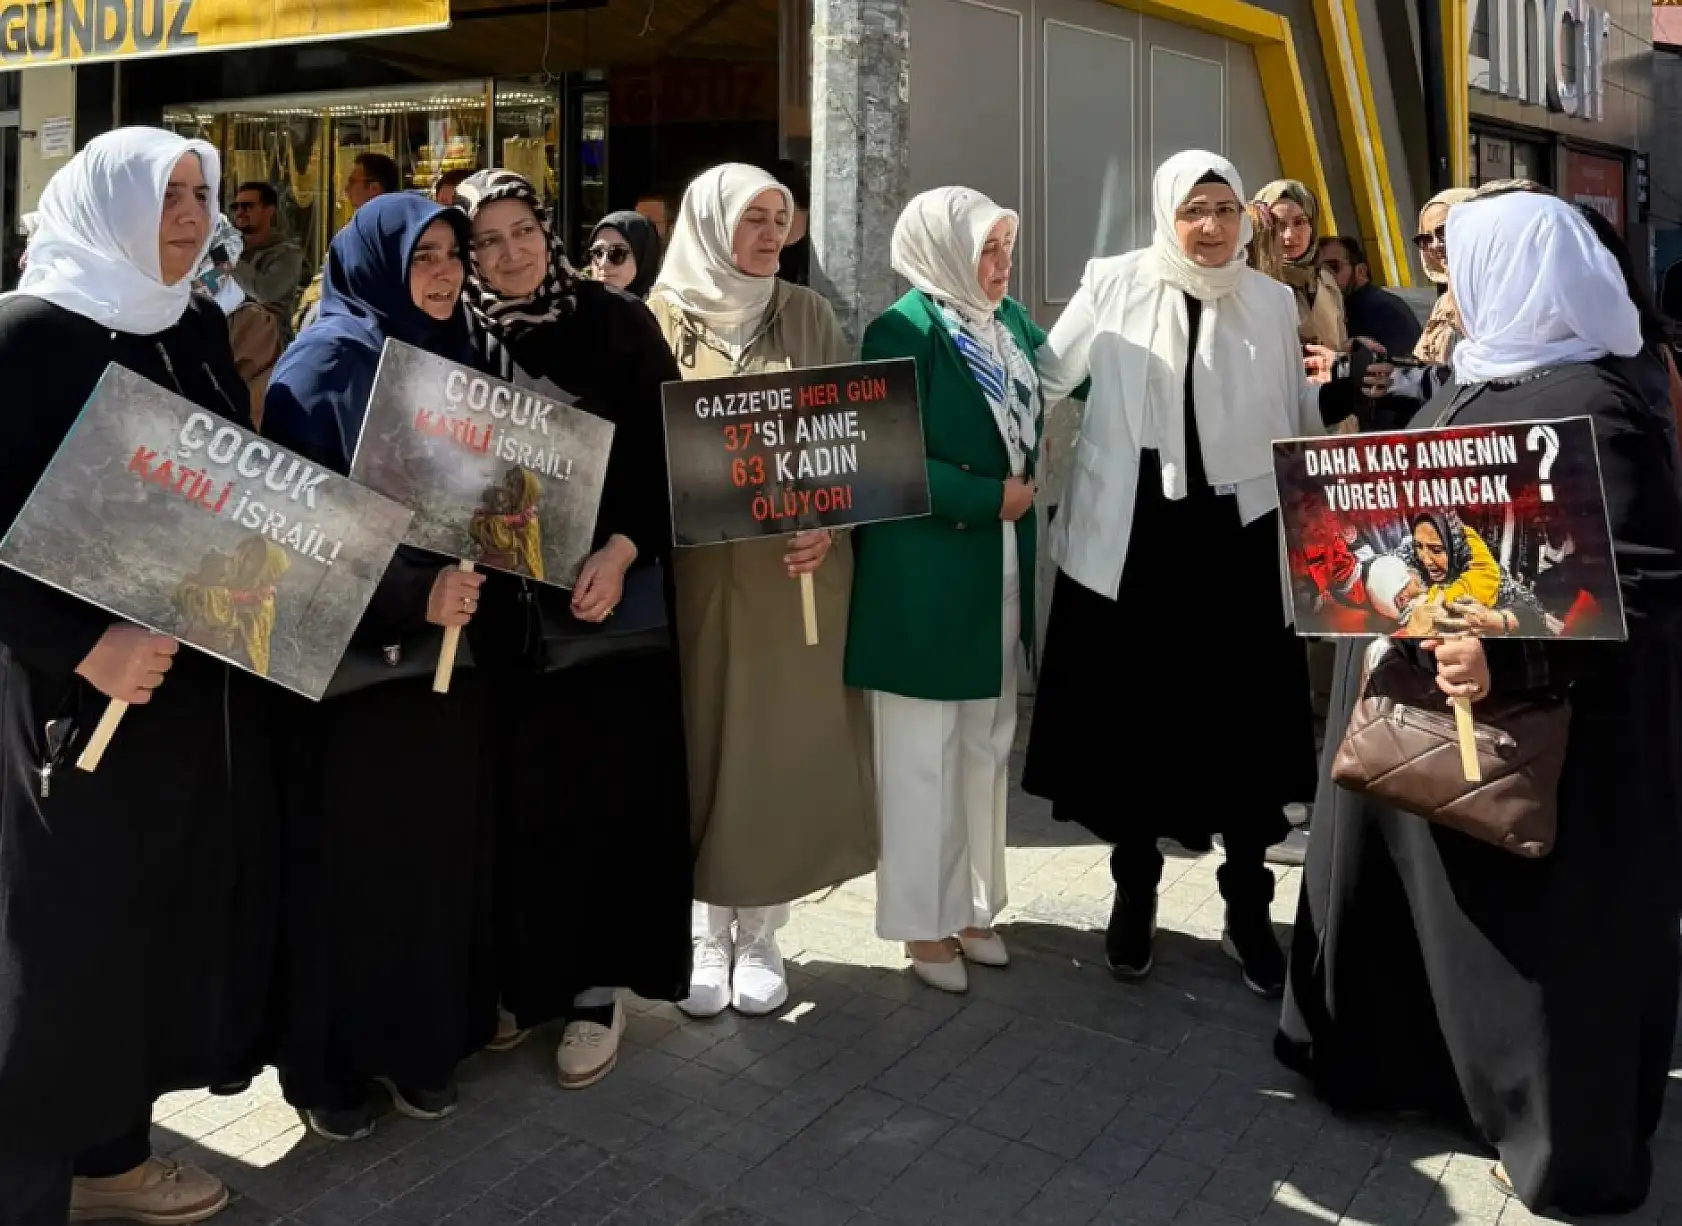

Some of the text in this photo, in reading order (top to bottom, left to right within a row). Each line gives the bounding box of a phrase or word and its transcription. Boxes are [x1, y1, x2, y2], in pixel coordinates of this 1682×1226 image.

[445, 369, 554, 435] ÇOCUK
[695, 377, 887, 419] GAZZE'DE HER GÜN
[723, 410, 867, 451] 37'Sİ ANNE,
[178, 412, 332, 509] ÇOCUK
[413, 408, 573, 481] KATİLİ İSRAİL!
[731, 443, 858, 487] 63 KADIN
[1304, 424, 1560, 503] DAHA KAÇ ANNENİN ?
[128, 444, 344, 567] KATİLİ İSRAİL!
[1324, 474, 1512, 512] YÜREĞİ YANACAK
